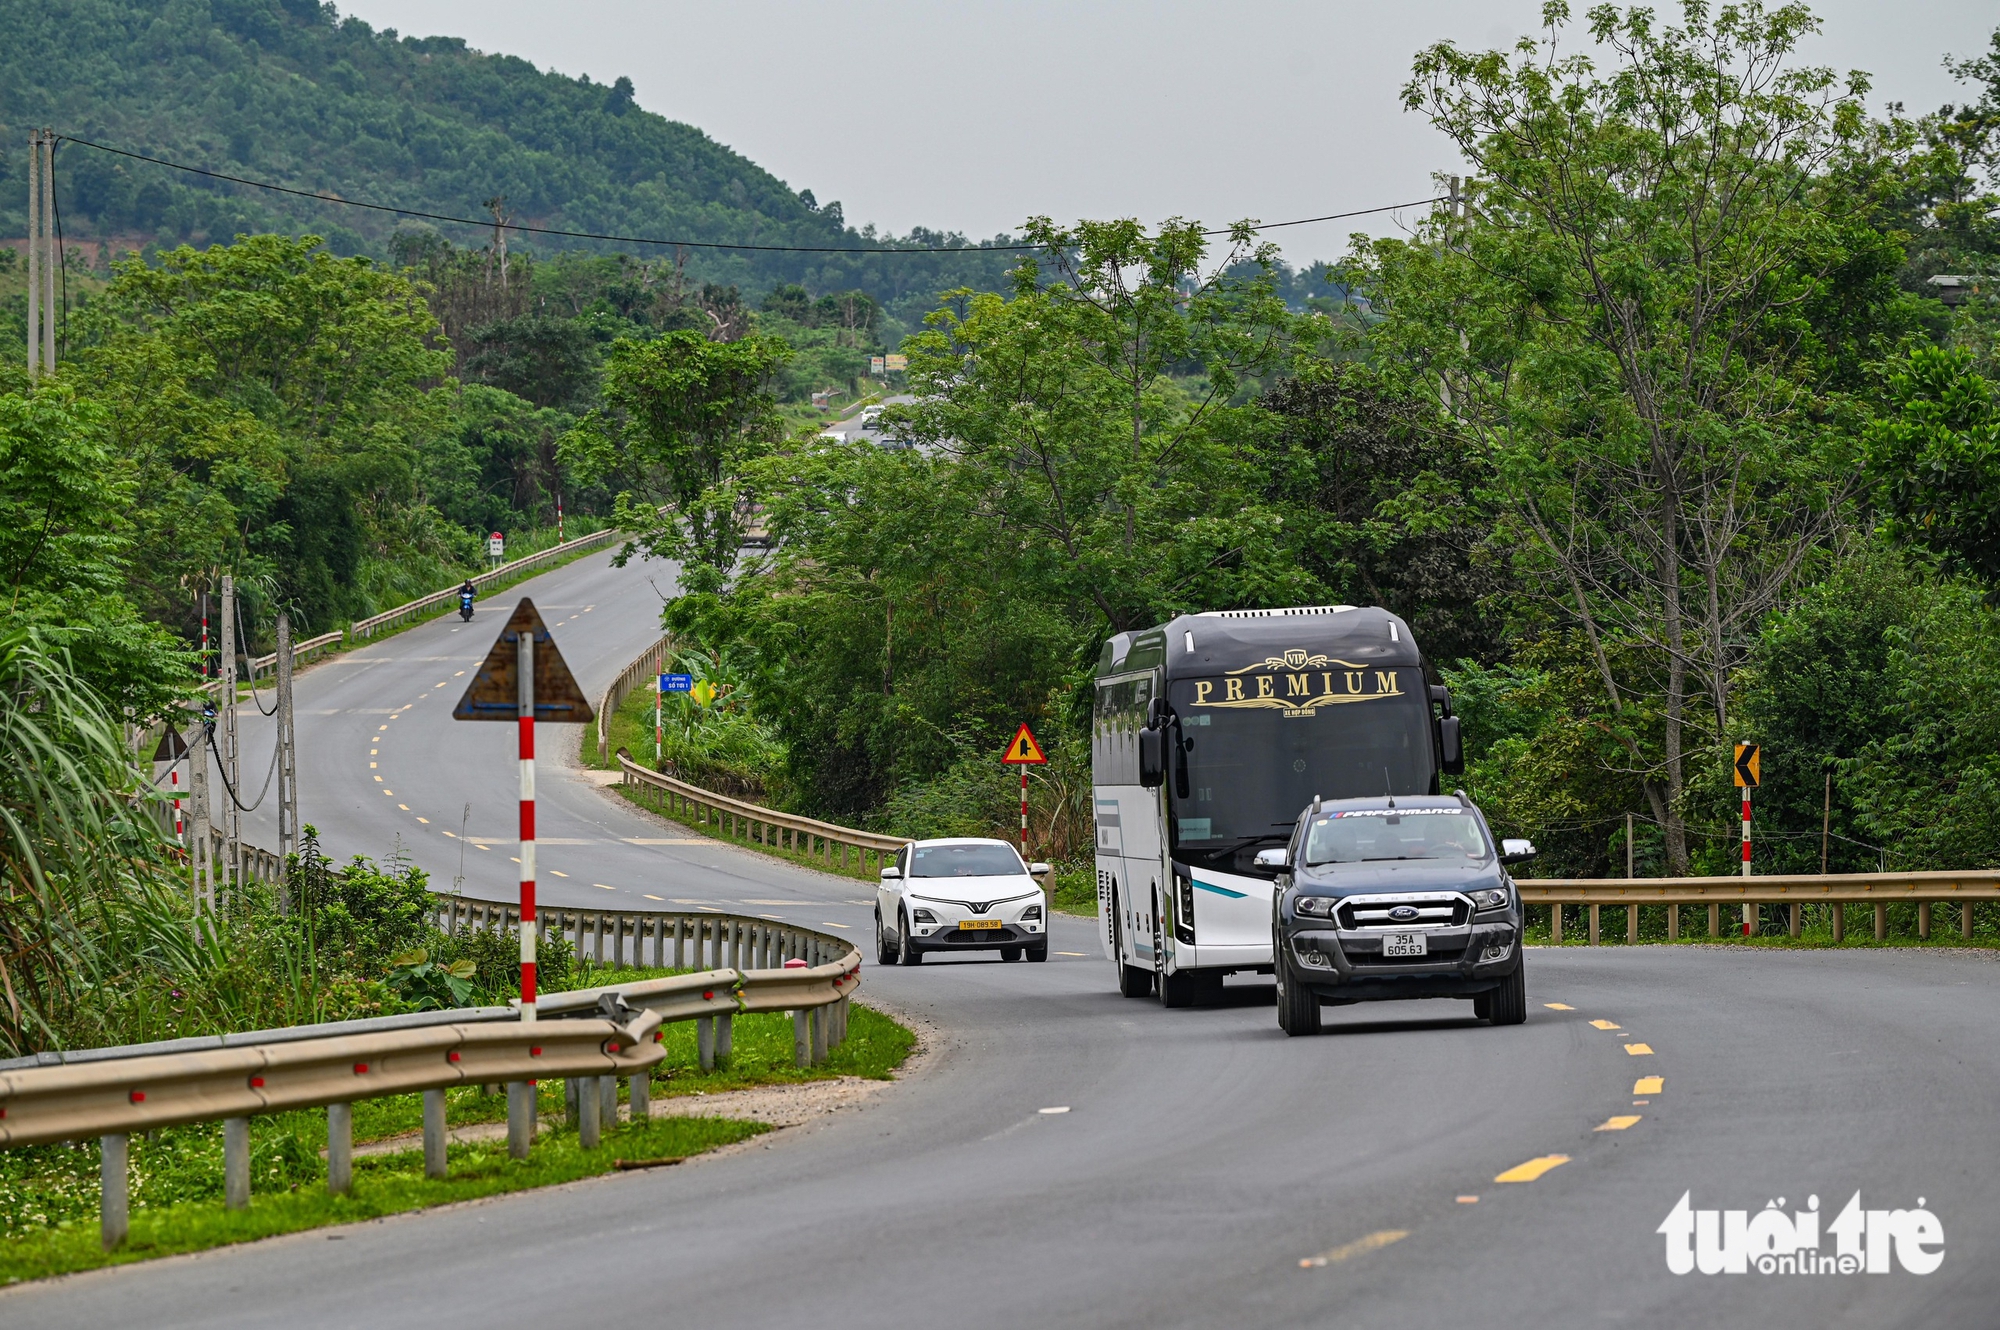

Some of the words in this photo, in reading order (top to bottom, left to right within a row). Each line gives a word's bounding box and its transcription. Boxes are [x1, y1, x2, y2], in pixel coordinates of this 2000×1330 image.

[1288, 653, 1305, 665] VIP
[1195, 671, 1399, 703] PREMIUM
[1343, 808, 1463, 818] PERFORMANCE
[1395, 909, 1412, 917] Ford
[1395, 935, 1415, 945] 35A
[1388, 945, 1423, 955] 605.63
